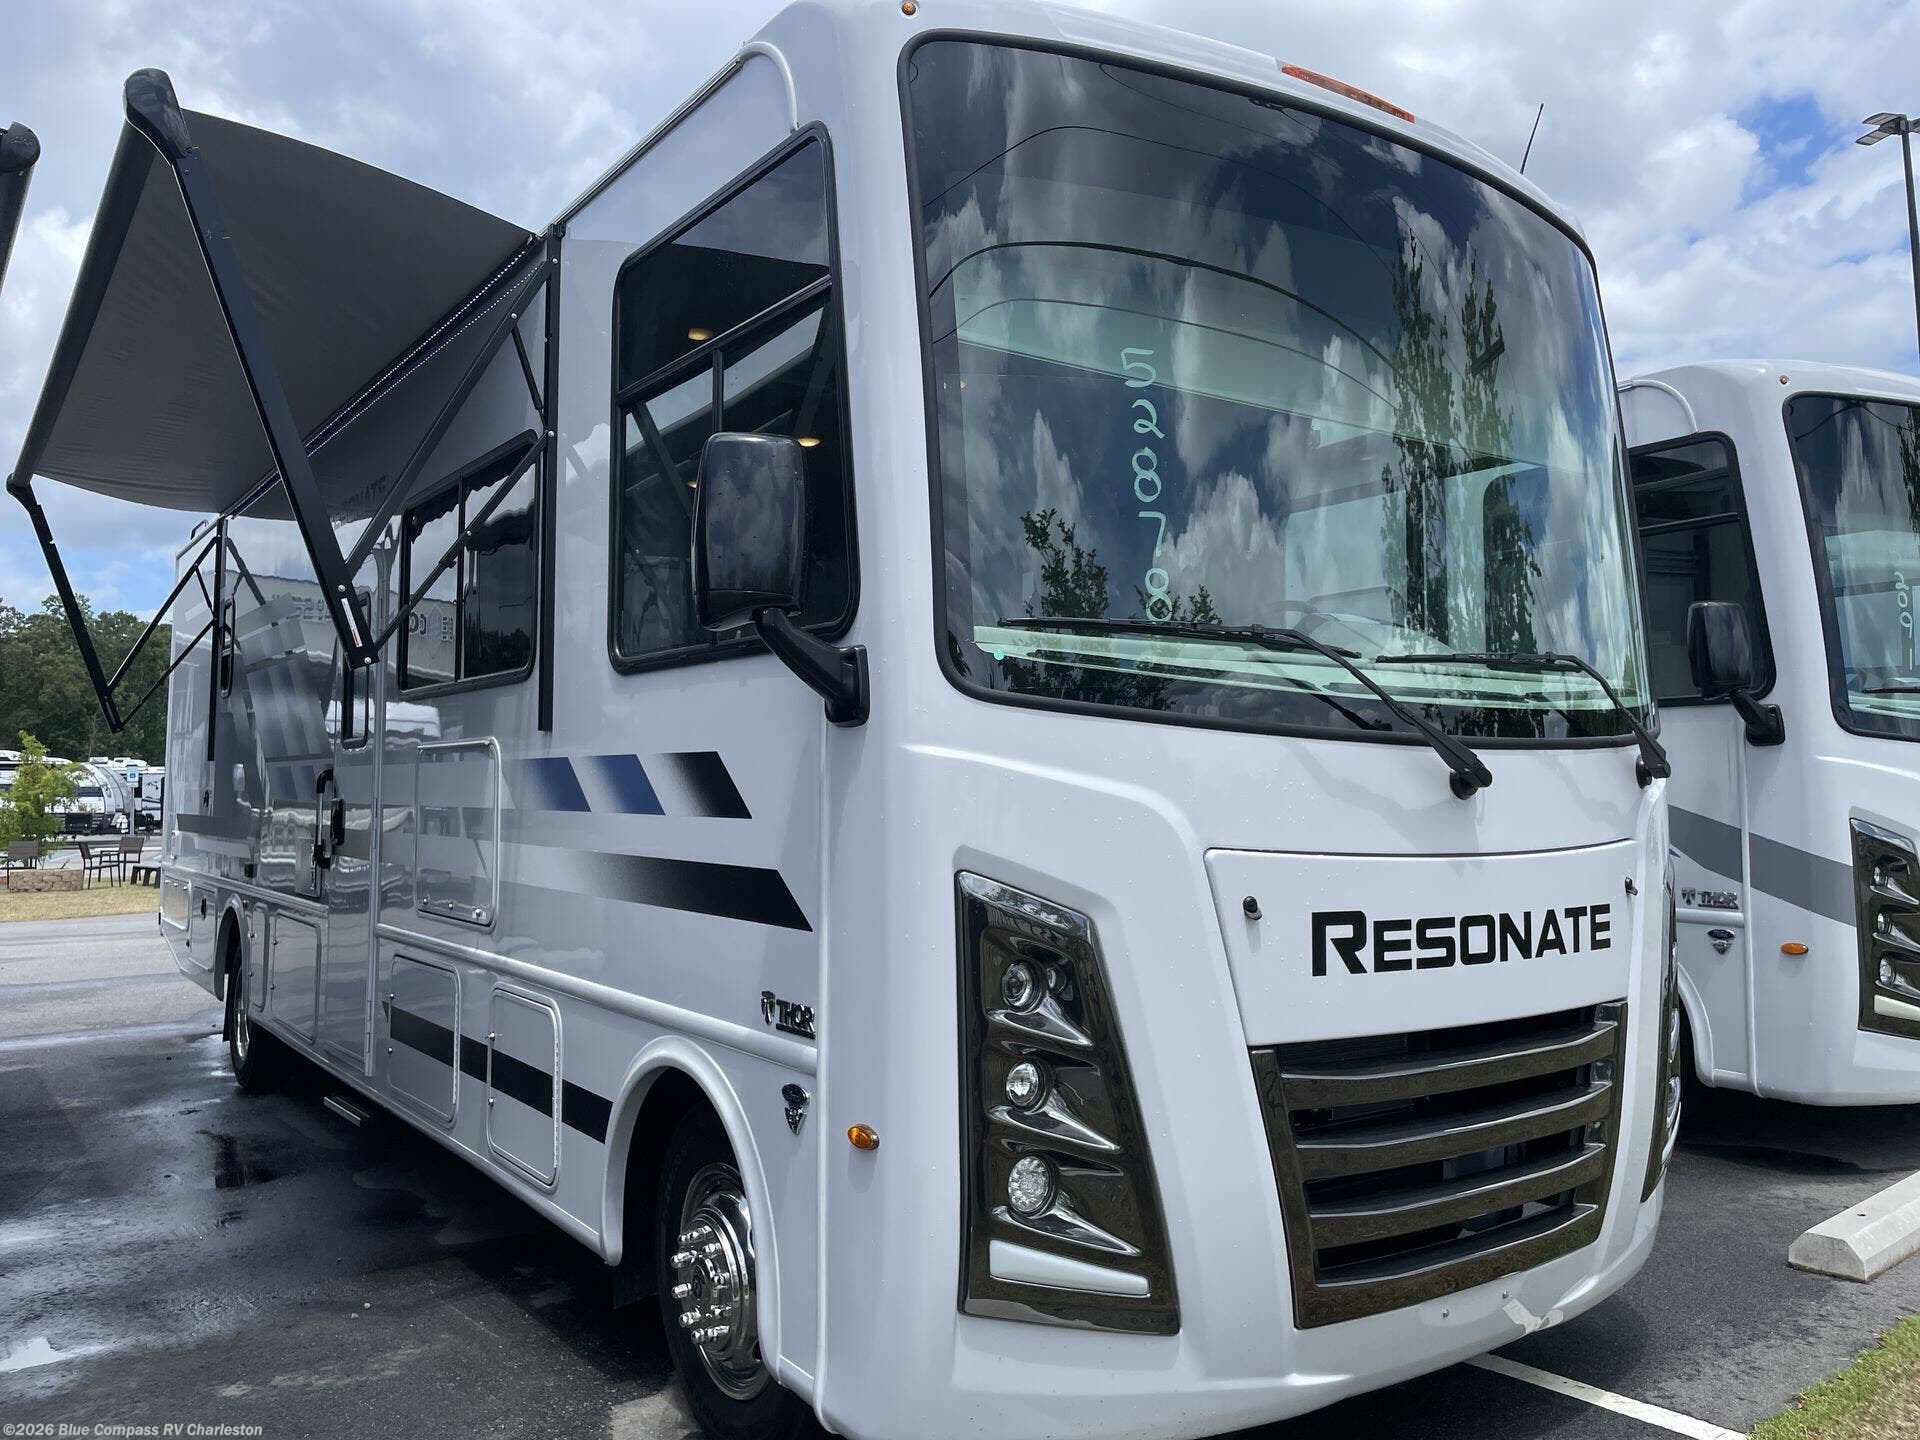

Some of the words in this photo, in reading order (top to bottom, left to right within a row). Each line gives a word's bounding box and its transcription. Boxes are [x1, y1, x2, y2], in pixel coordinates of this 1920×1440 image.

[1120, 347, 1173, 623] 52878
[1697, 891, 1739, 909] THOR
[776, 998, 815, 1034] THOR
